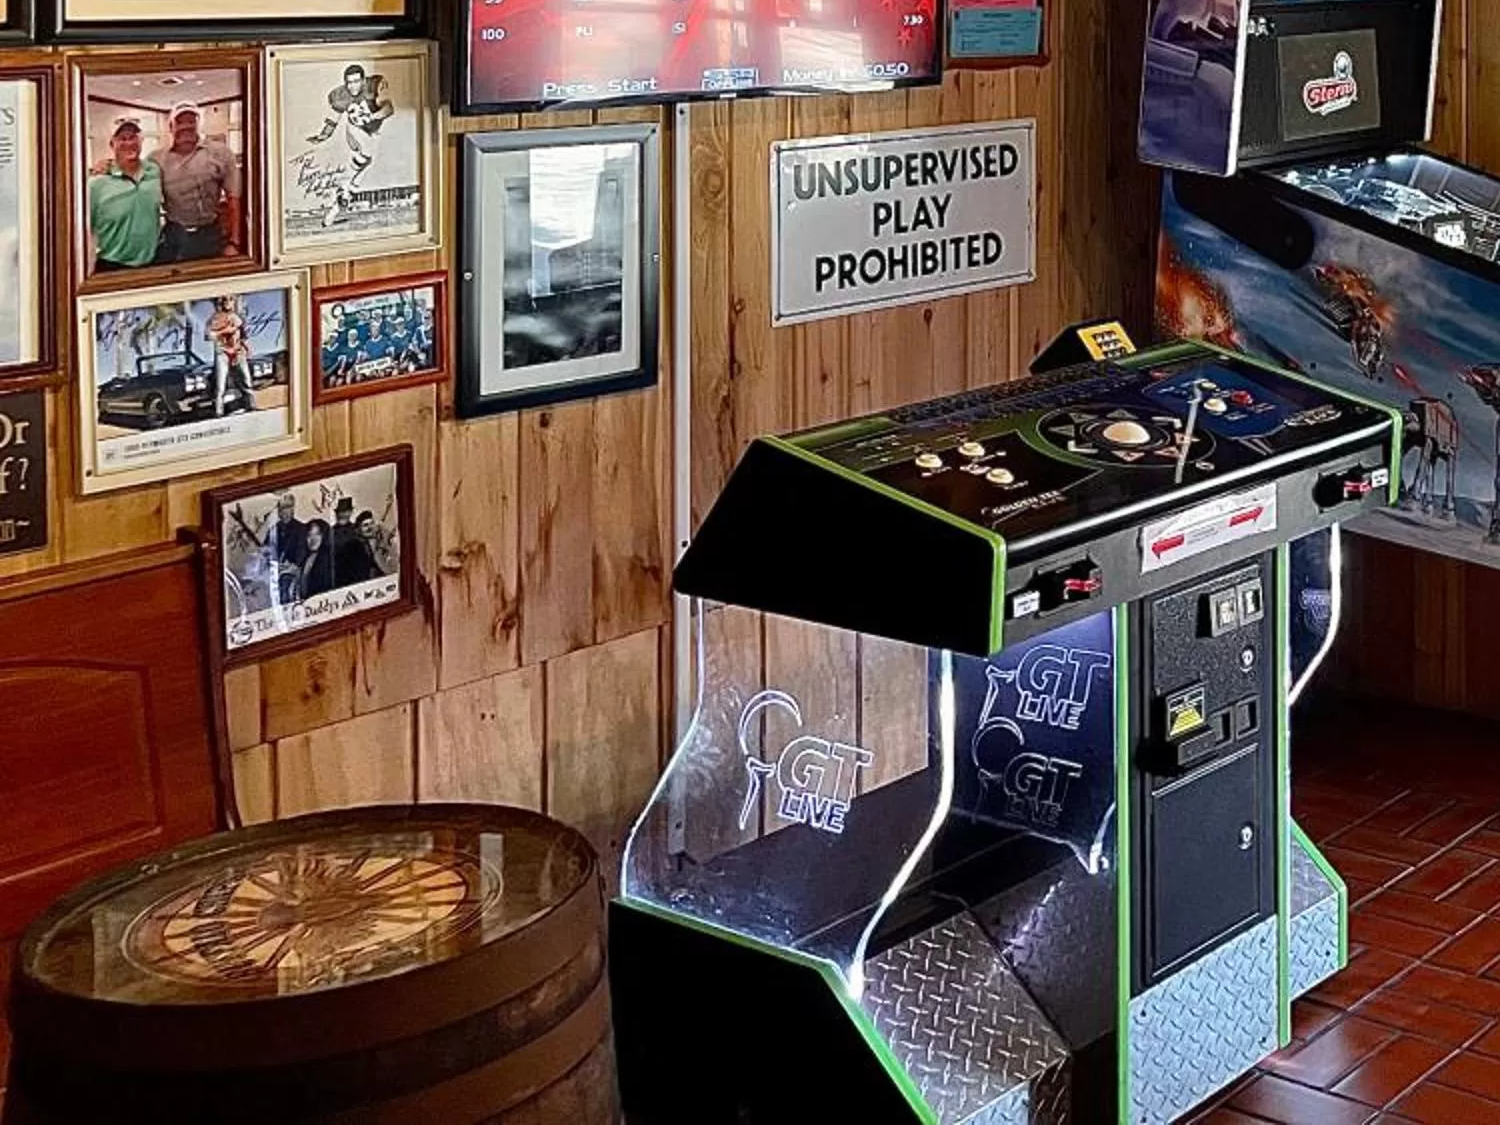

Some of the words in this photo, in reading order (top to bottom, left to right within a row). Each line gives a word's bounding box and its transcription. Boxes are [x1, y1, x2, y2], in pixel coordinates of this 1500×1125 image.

[481, 28, 506, 41] 100
[607, 75, 660, 94] Start
[793, 142, 1019, 200] UNSUPERVISED
[872, 192, 953, 237] PLAY
[814, 231, 1004, 293] PROHIBITED
[1014, 644, 1111, 705] GT
[1015, 690, 1088, 730] LIVE
[776, 735, 874, 805] GT
[777, 787, 850, 834] LIVE
